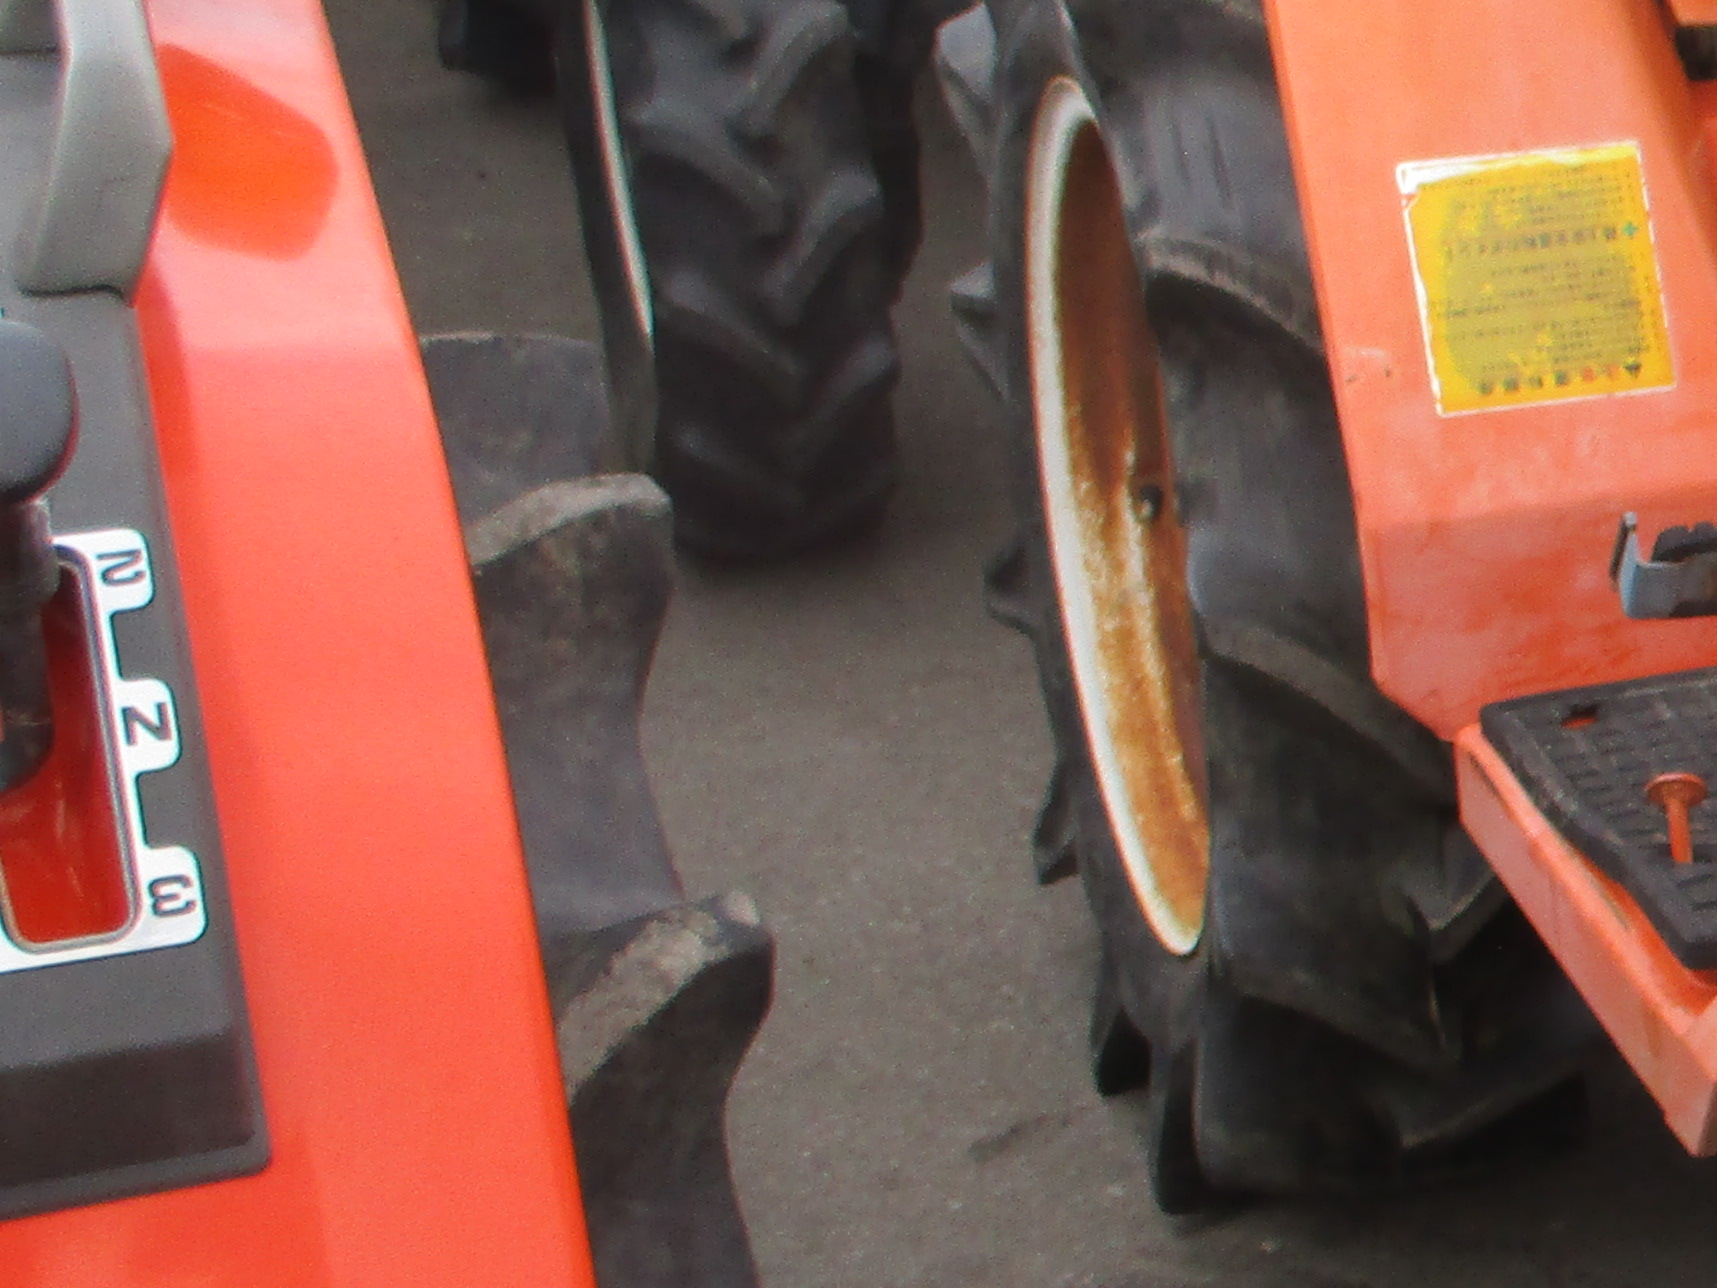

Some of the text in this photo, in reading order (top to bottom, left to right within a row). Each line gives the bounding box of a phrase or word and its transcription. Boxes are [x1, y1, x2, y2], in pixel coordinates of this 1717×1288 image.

[98, 547, 148, 588] 2
[120, 701, 173, 747] N
[147, 874, 197, 920] 3
